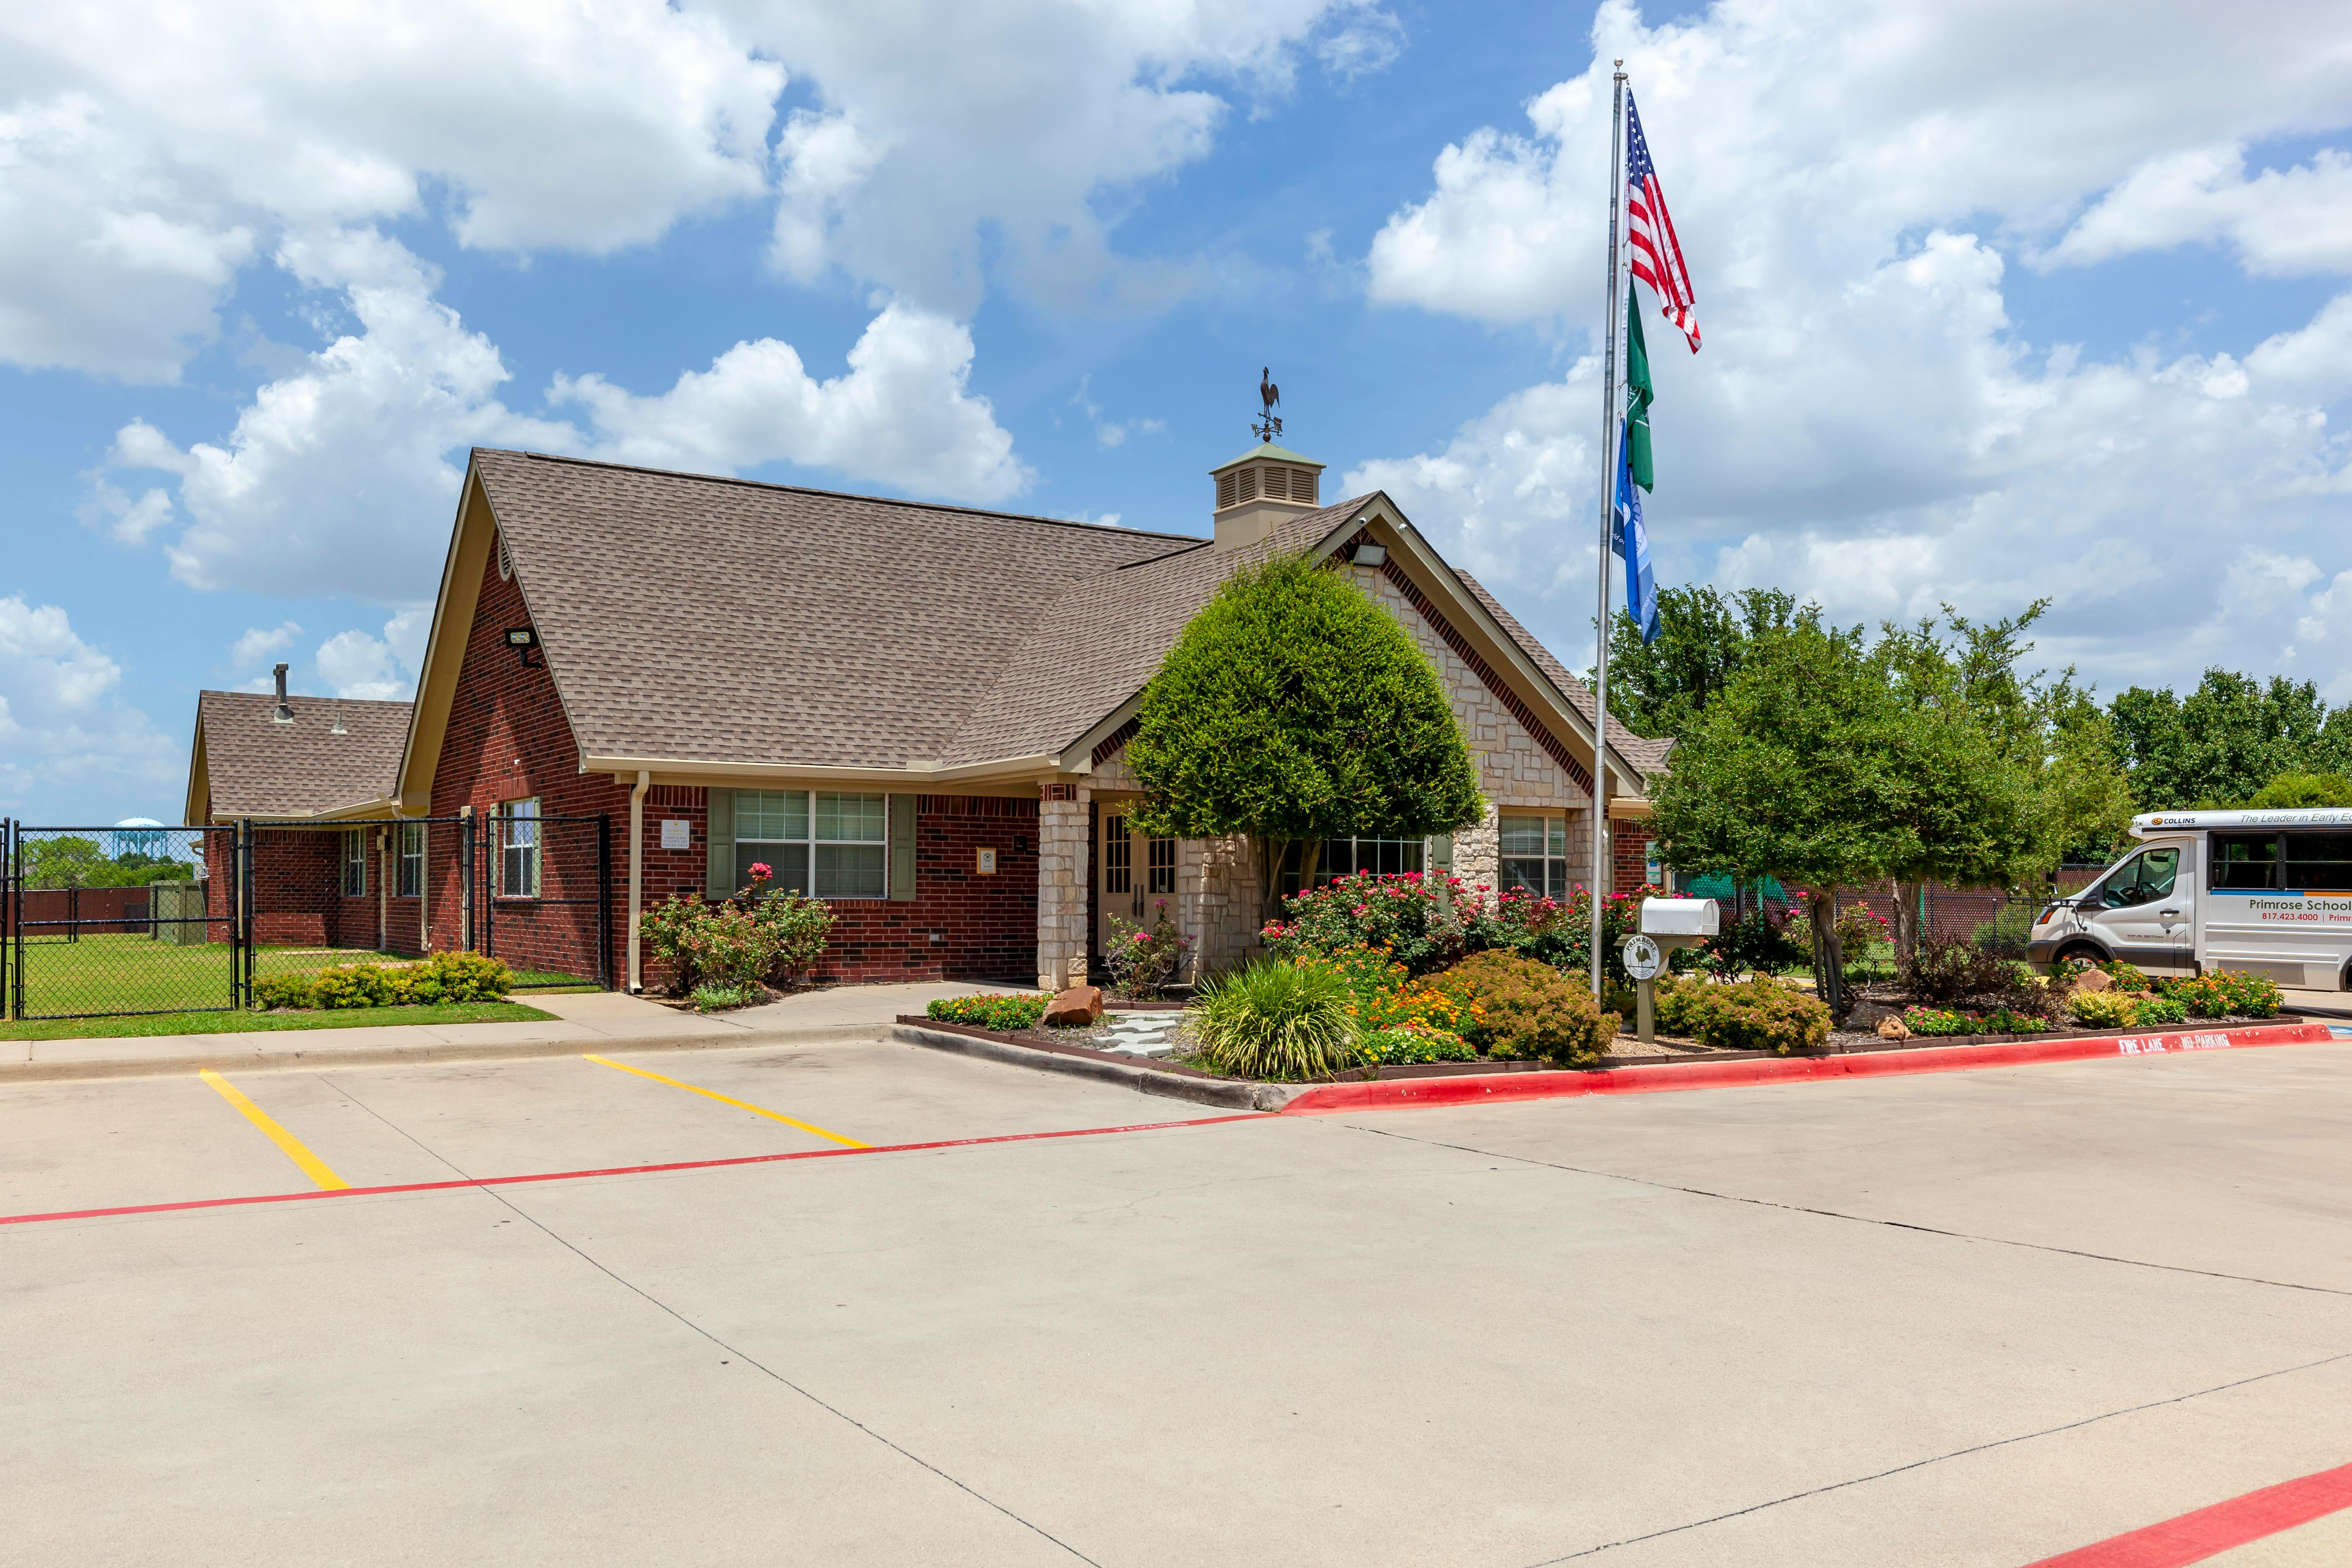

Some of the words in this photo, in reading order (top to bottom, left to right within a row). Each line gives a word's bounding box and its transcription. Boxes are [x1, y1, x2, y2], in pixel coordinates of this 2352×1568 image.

[2311, 813, 2339, 823] Early
[2250, 900, 2303, 910] Primrose
[2307, 900, 2351, 910] School
[1626, 937, 1657, 952] PRIMROSE
[2118, 1039, 2141, 1055] FIRE
[2141, 1038, 2166, 1052] LANE
[2180, 1036, 2194, 1049] NO
[2194, 1034, 2230, 1048] PARKING
